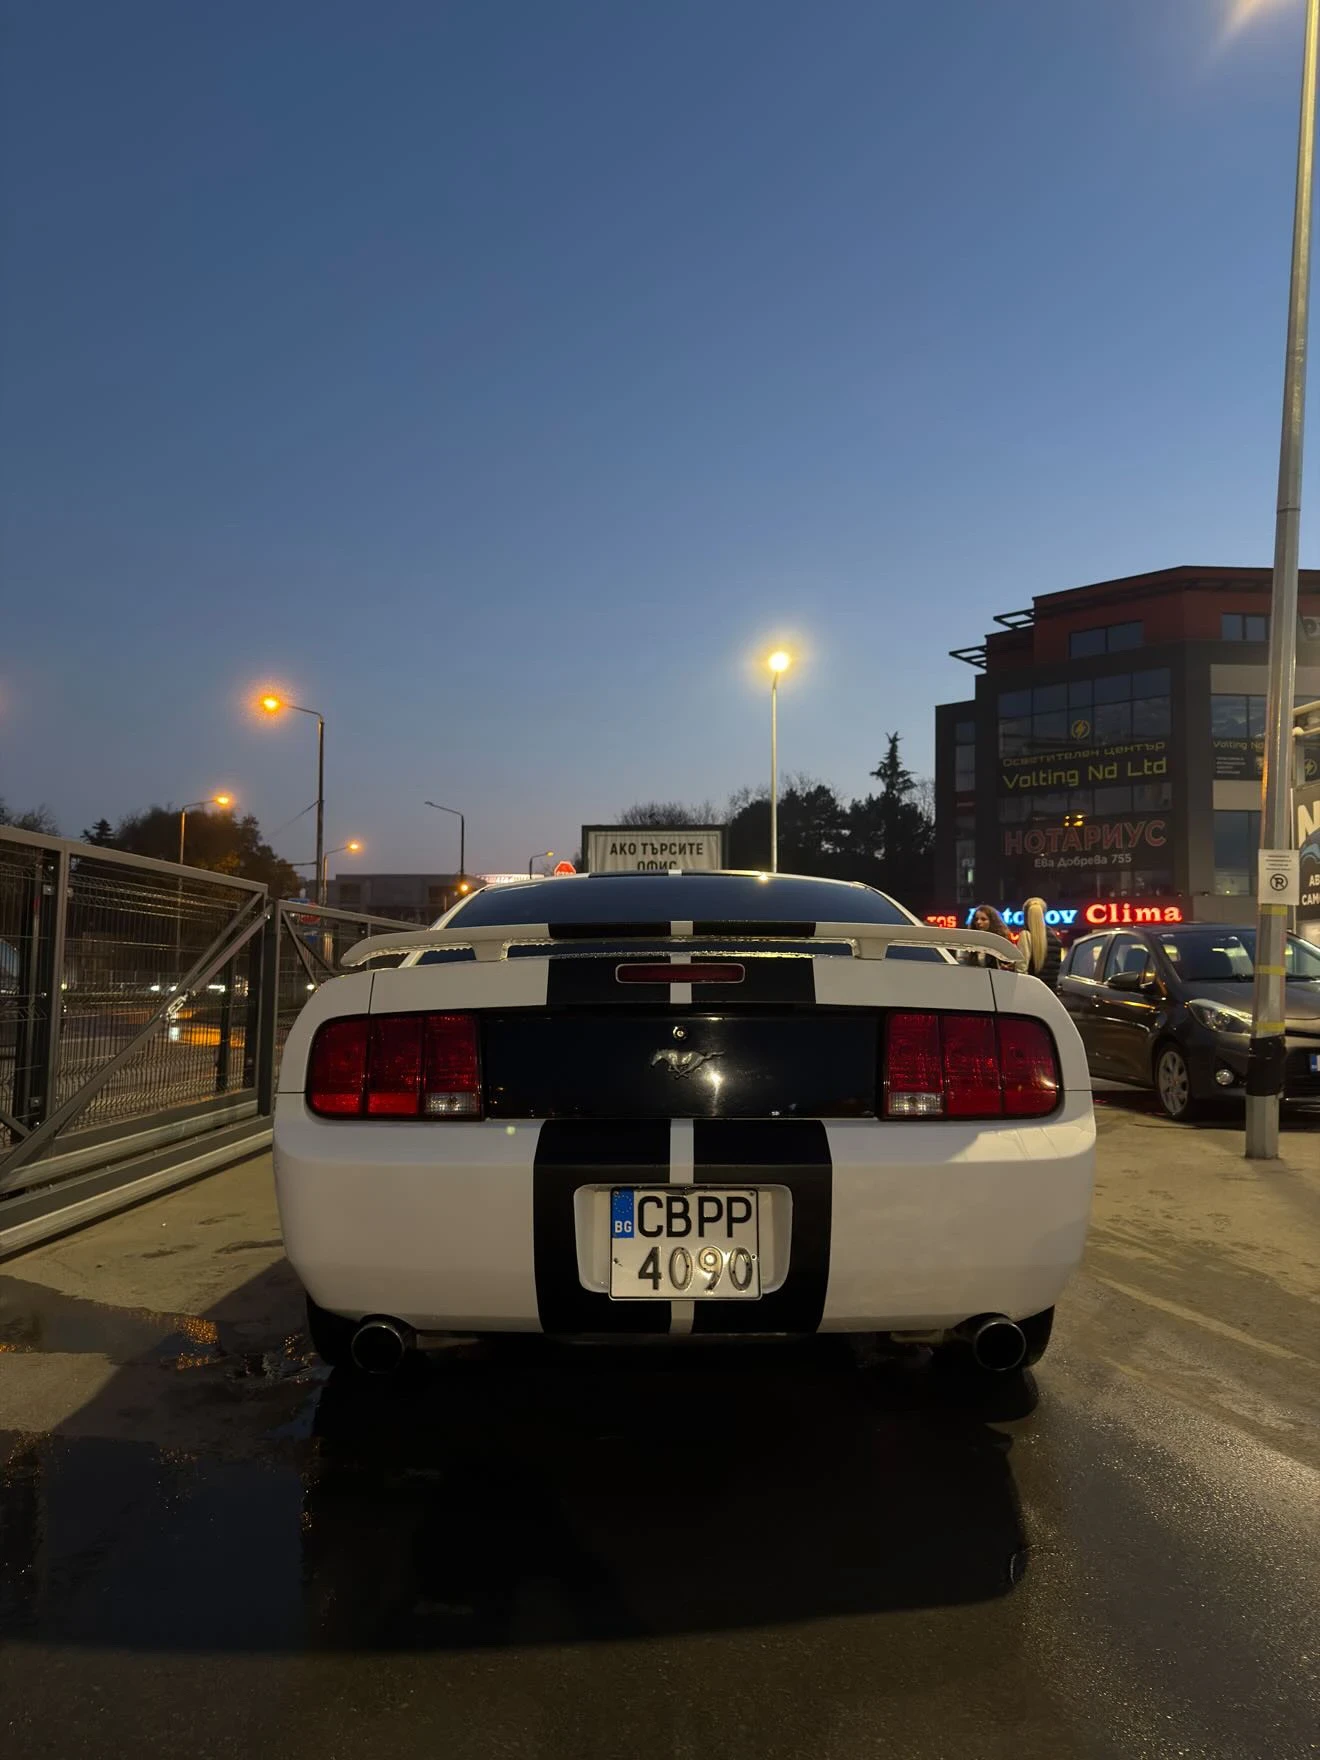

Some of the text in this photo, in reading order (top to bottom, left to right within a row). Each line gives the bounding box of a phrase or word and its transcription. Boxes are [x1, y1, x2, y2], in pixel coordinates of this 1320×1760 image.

[1088, 762, 1118, 781] Nd
[1127, 756, 1168, 777] Ltd
[610, 842, 704, 855] АКО ТЪРСИТЕ
[1004, 819, 1168, 856] НОТАРИУС
[1033, 858, 1054, 868] Ева
[1111, 853, 1132, 864] 755
[1085, 903, 1183, 925] Clima
[614, 1220, 632, 1233] BG
[637, 1195, 753, 1238] CBPP
[637, 1245, 753, 1292] 4090
